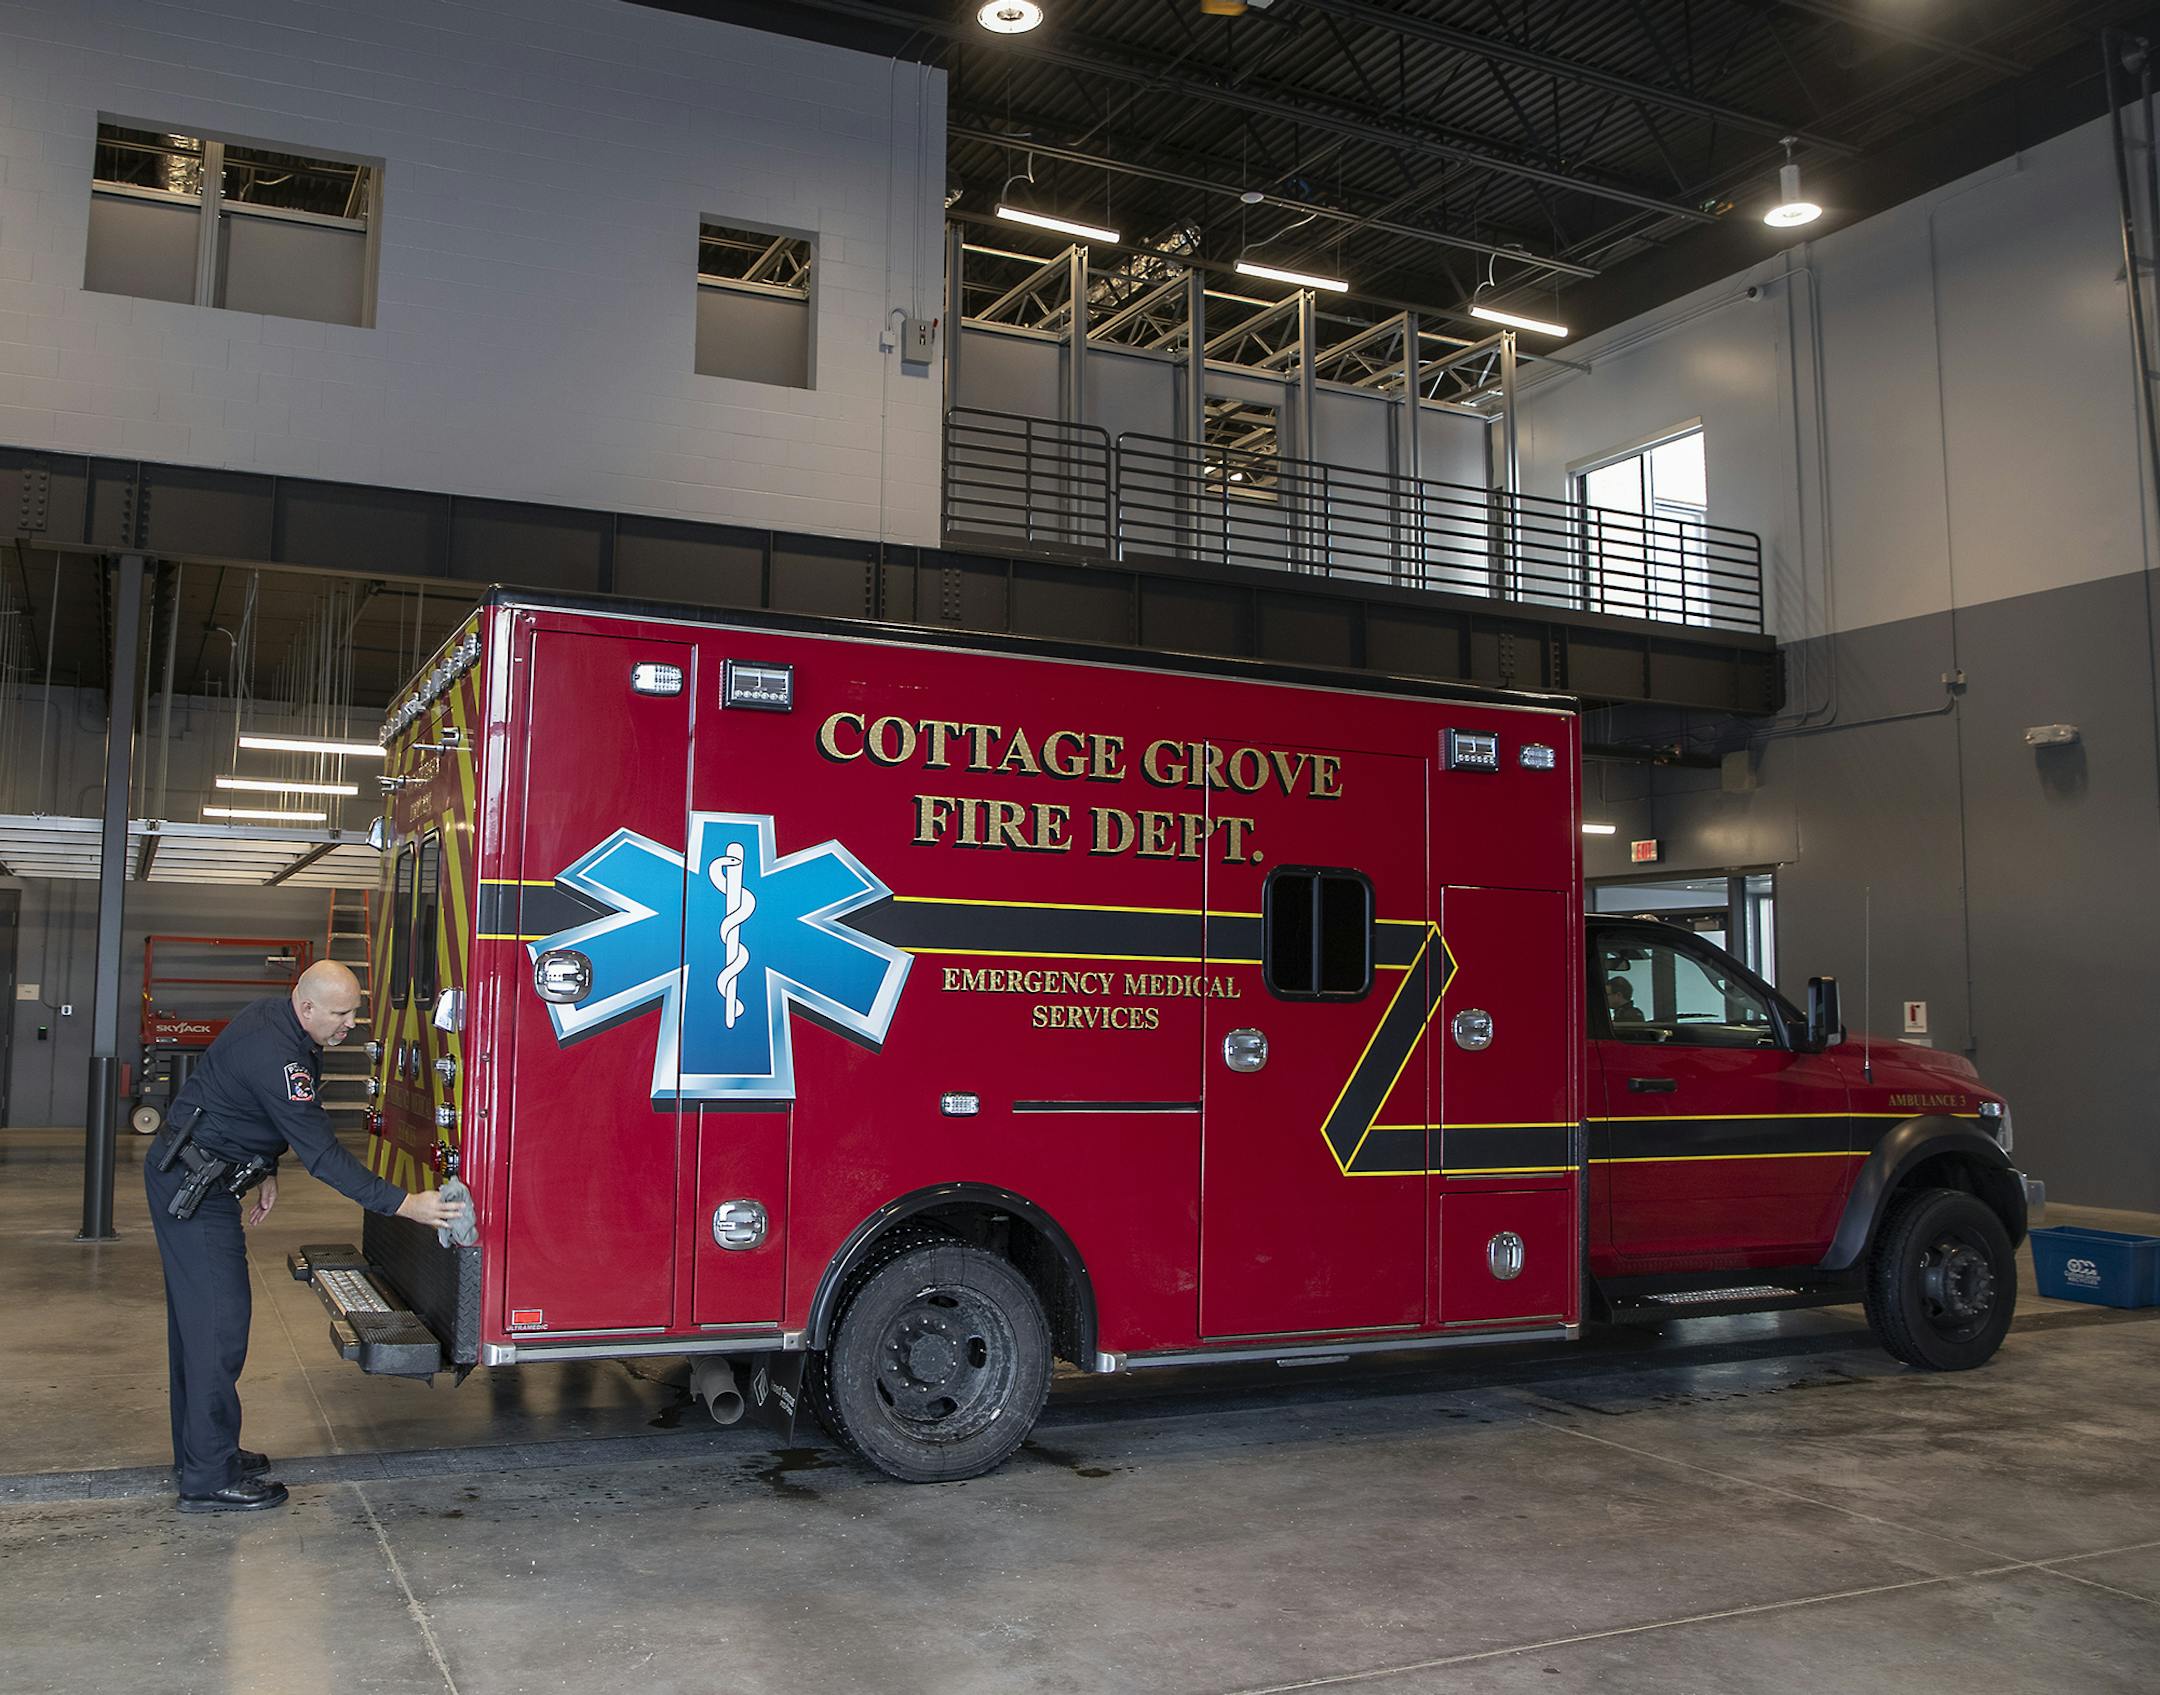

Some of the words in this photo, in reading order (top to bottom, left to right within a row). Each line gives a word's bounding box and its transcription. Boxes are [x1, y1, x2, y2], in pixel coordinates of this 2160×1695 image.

[817, 711, 1128, 782] COTTAGE
[1140, 739, 1343, 798] GROVE
[911, 794, 1073, 853] FIRE
[1087, 806, 1265, 865] DEPT.
[942, 967, 1115, 996] EMERGENCY
[1124, 972, 1242, 999] MEDICAL
[156, 1022, 211, 1034] SKYJACK
[1032, 1004, 1160, 1031] SERVICES
[1888, 1094, 1956, 1106] AMBULANCE
